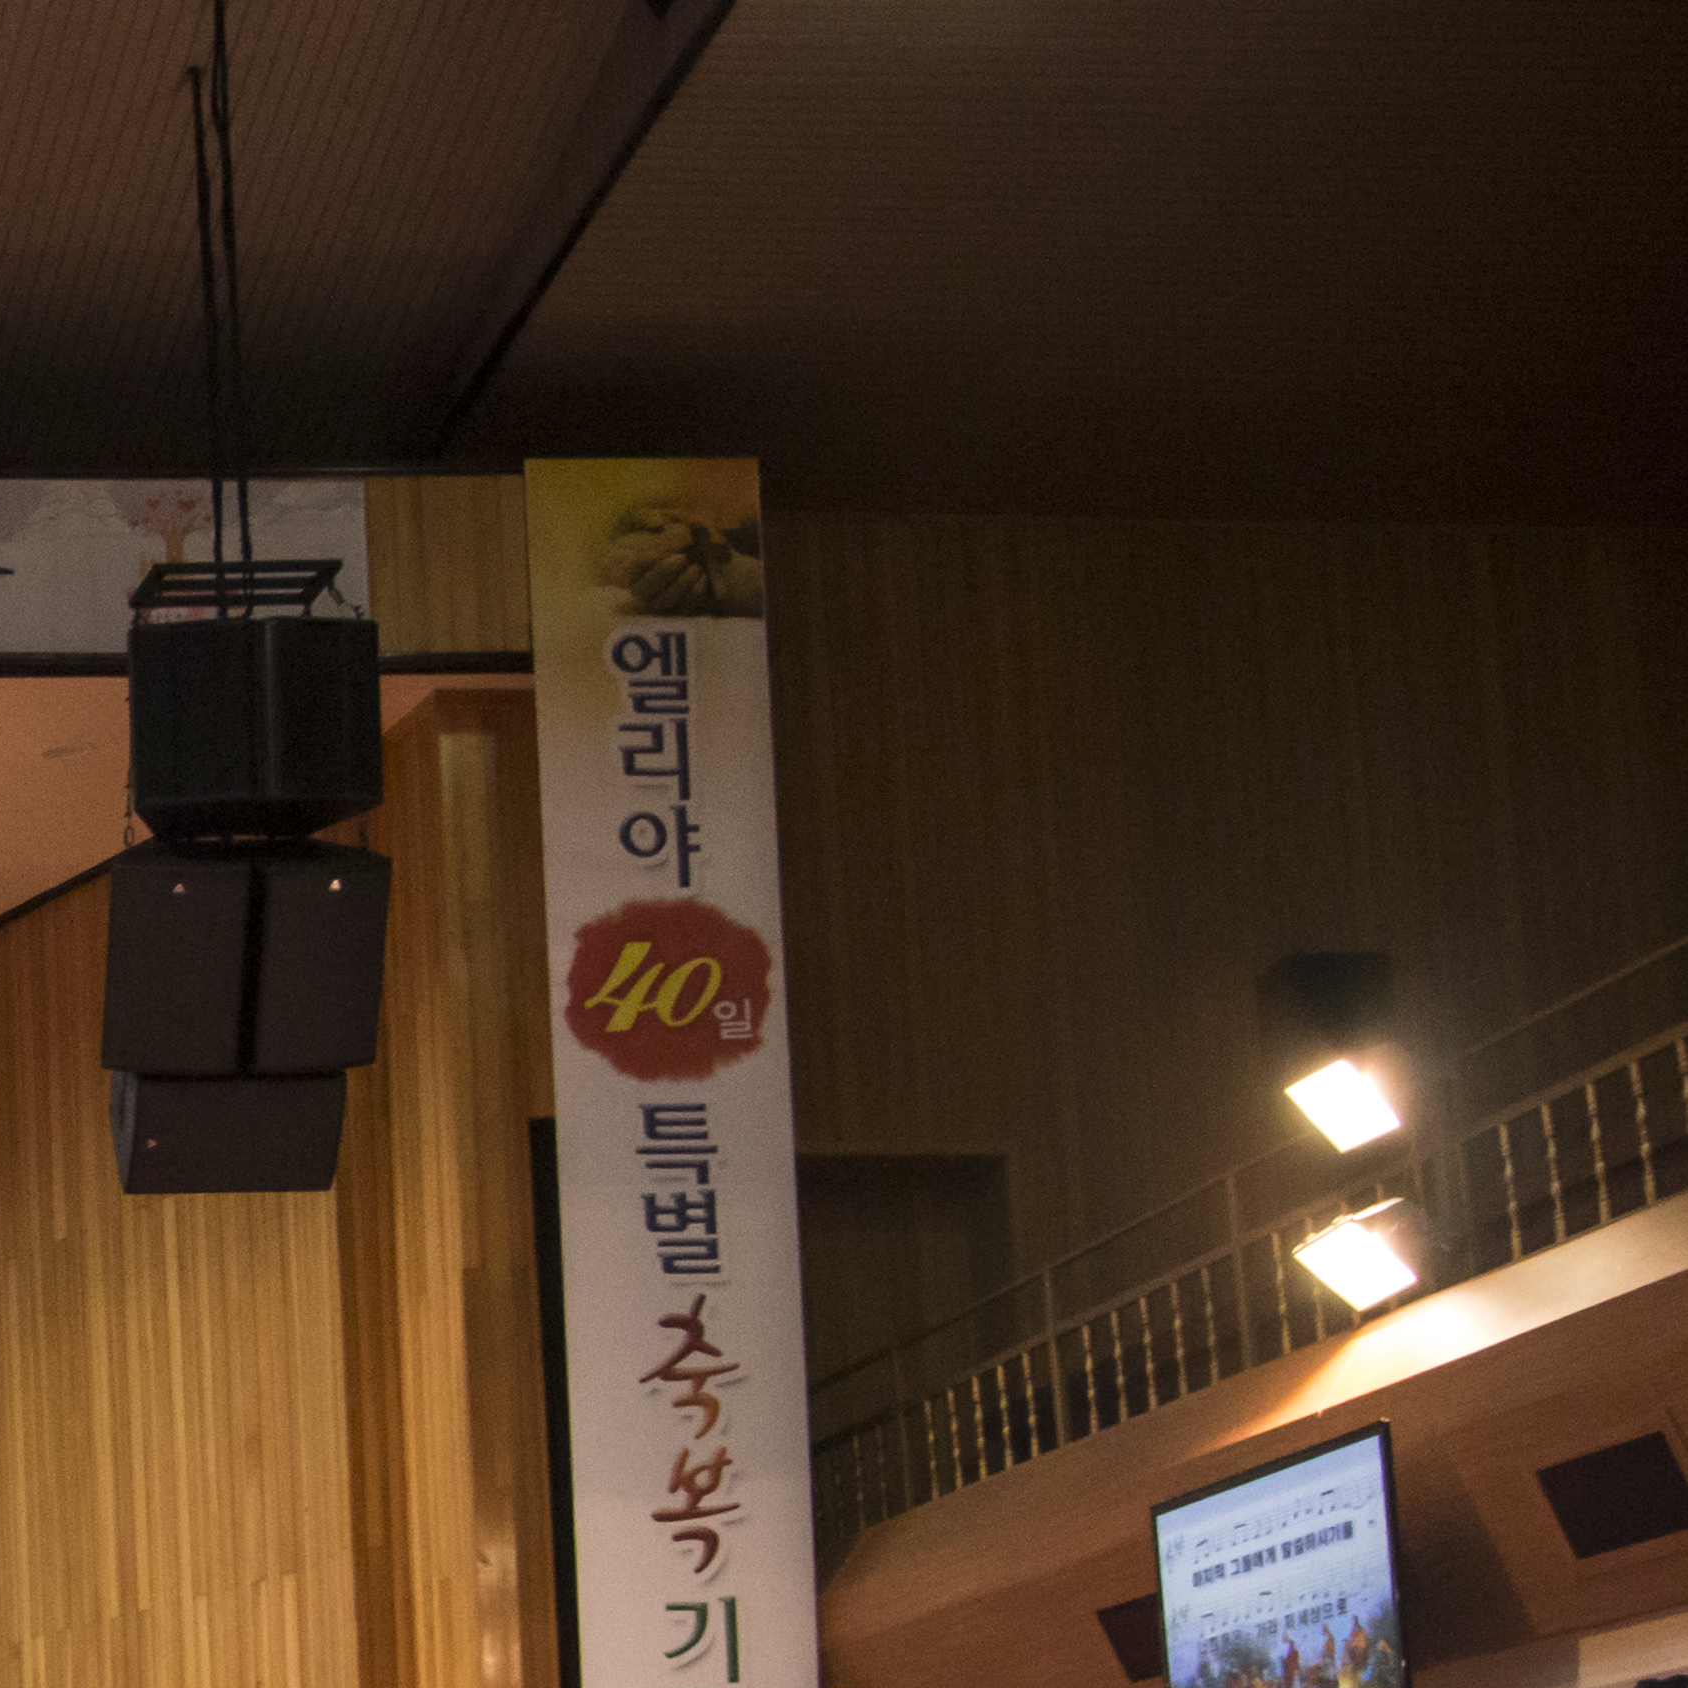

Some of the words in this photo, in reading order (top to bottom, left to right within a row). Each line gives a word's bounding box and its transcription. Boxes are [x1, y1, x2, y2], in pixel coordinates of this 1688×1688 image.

[609, 630, 704, 890] 엘리야
[635, 1103, 722, 1276] 특별
[638, 1294, 743, 1576] 축복
